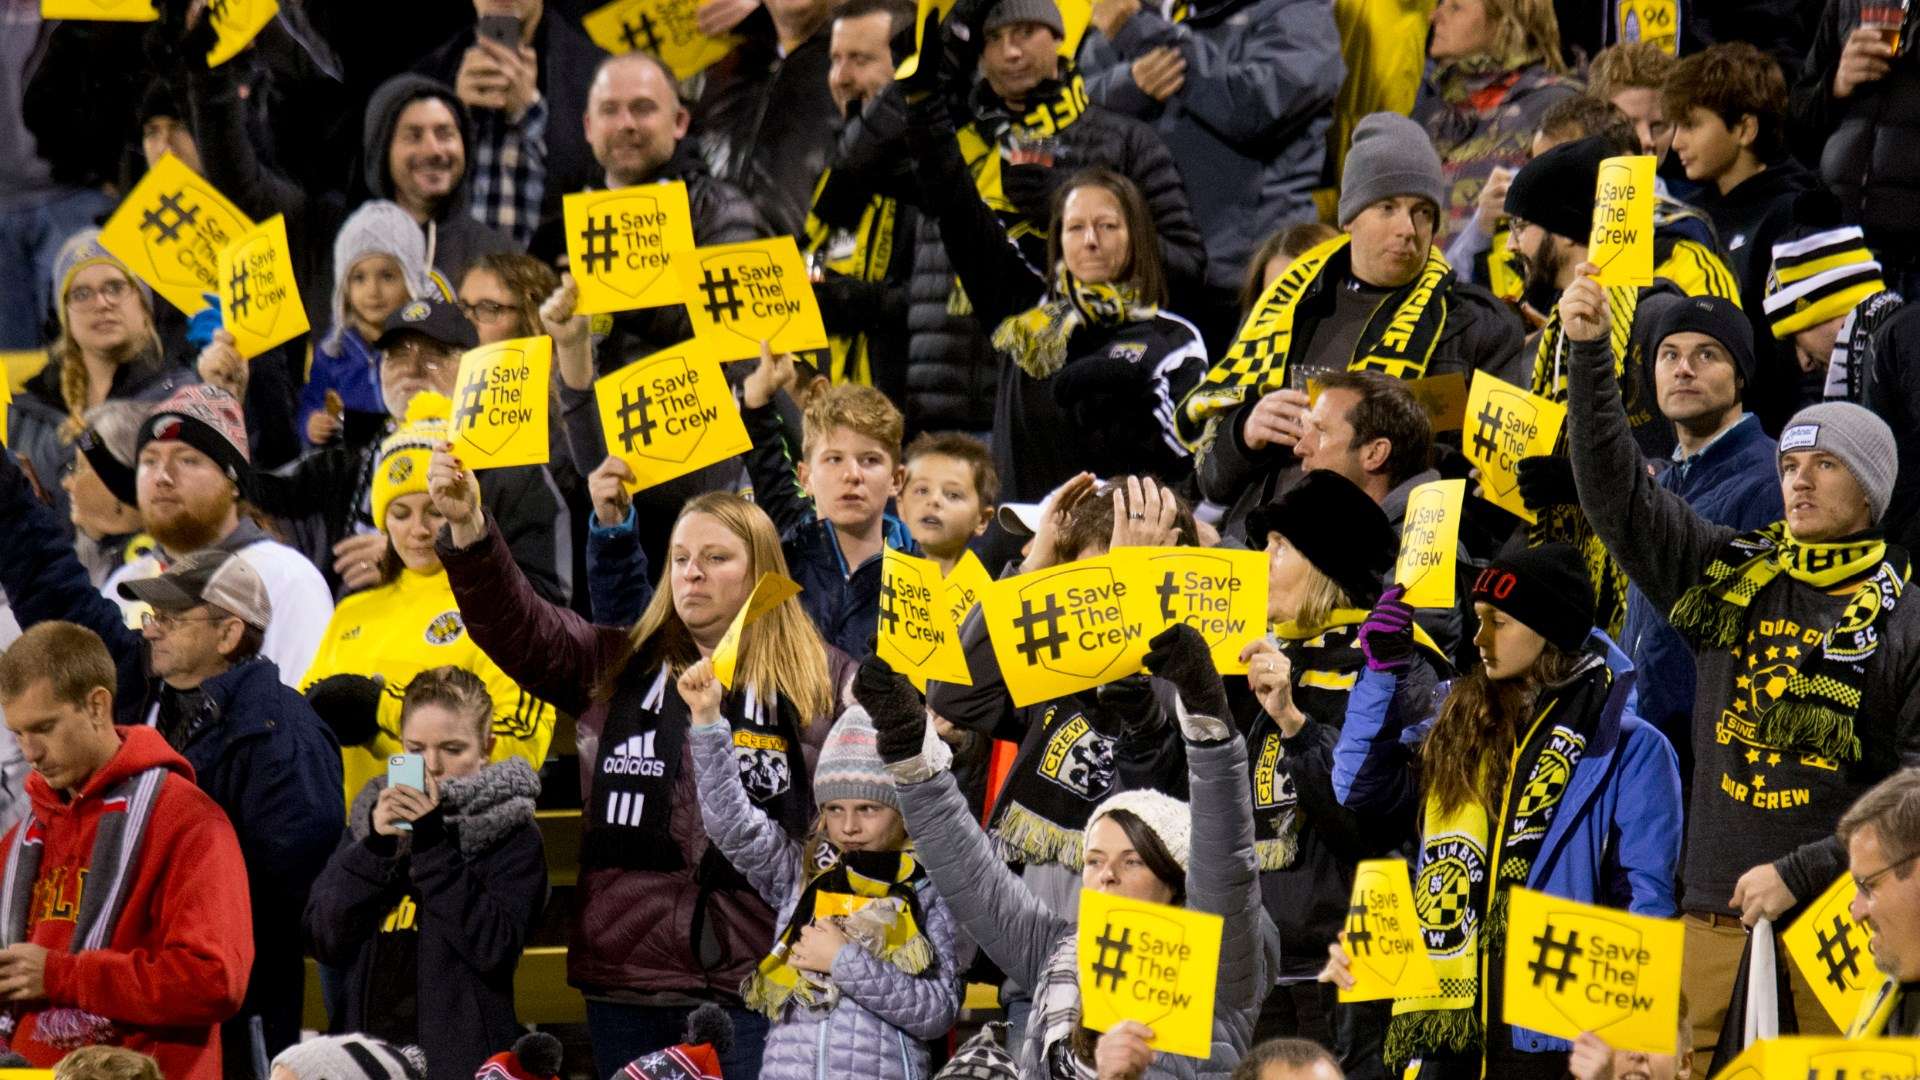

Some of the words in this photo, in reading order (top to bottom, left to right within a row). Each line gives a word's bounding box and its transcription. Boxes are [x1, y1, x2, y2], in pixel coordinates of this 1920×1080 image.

[1644, 7, 1670, 27] 96
[1603, 182, 1636, 201] Save
[620, 210, 667, 231] Save
[1601, 203, 1625, 222] The
[622, 231, 660, 249] The
[1595, 225, 1637, 244] Crew
[250, 247, 276, 269] Save
[252, 270, 274, 286] The
[737, 263, 784, 282] Save
[255, 286, 286, 310] Crew
[743, 283, 782, 300] The
[752, 299, 801, 318] Crew
[491, 366, 530, 384] Save
[652, 367, 699, 398] Save
[490, 386, 520, 405] The
[657, 391, 697, 417] The
[488, 407, 533, 426] Crew
[665, 405, 718, 436] Crew
[1505, 411, 1538, 440] Save
[1503, 431, 1524, 457] The
[1500, 452, 1520, 476] Cr
[1417, 507, 1445, 525] Save
[1414, 526, 1435, 544] The
[1407, 547, 1443, 567] Crew
[897, 577, 931, 602] Save
[1184, 571, 1242, 592] Save
[1066, 581, 1127, 608] Save
[1184, 593, 1228, 612] The
[900, 600, 929, 621] The
[951, 588, 976, 623] ave
[1070, 604, 1120, 630] The
[1184, 614, 1246, 635] Crew
[905, 621, 944, 644] Crew
[1078, 622, 1142, 651] Crew
[1802, 629, 1824, 647] CI
[1727, 719, 1756, 739] SINC
[739, 732, 788, 751] CREW
[1045, 719, 1086, 772] CREW
[603, 755, 666, 777] adidas
[1260, 735, 1279, 802] CREW
[1752, 788, 1810, 810] CREW
[1420, 842, 1484, 883] LUMBUS
[1369, 890, 1399, 910] Save
[1372, 912, 1399, 932] The
[1138, 931, 1192, 961] Save
[1378, 935, 1415, 956] Crew
[1589, 935, 1651, 966] Save
[1136, 955, 1177, 982] The
[1588, 958, 1636, 986] The
[1132, 979, 1192, 1010] Crew
[1584, 983, 1655, 1012] Crew
